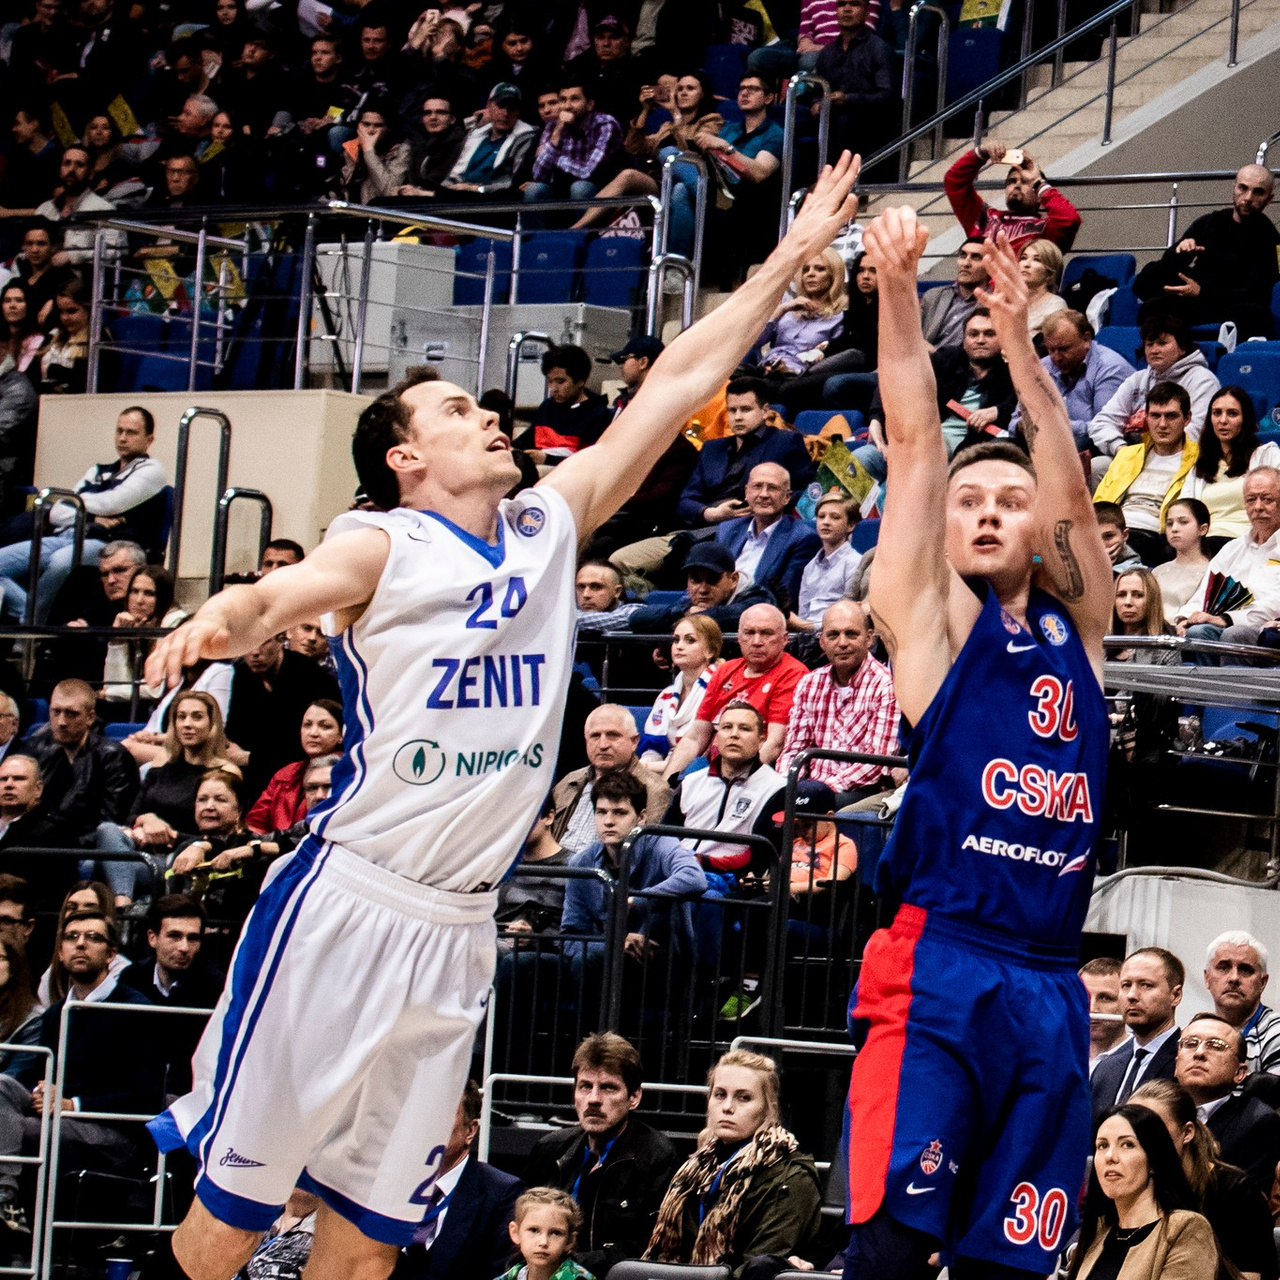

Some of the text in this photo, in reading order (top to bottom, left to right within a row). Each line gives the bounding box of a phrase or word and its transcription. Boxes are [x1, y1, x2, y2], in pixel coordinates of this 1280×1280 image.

[465, 576, 527, 630] 24
[426, 653, 545, 710] ZENIT
[981, 758, 1093, 823] CSKA
[961, 834, 1067, 868] AEROFLOT
[1003, 1182, 1068, 1251] 30
